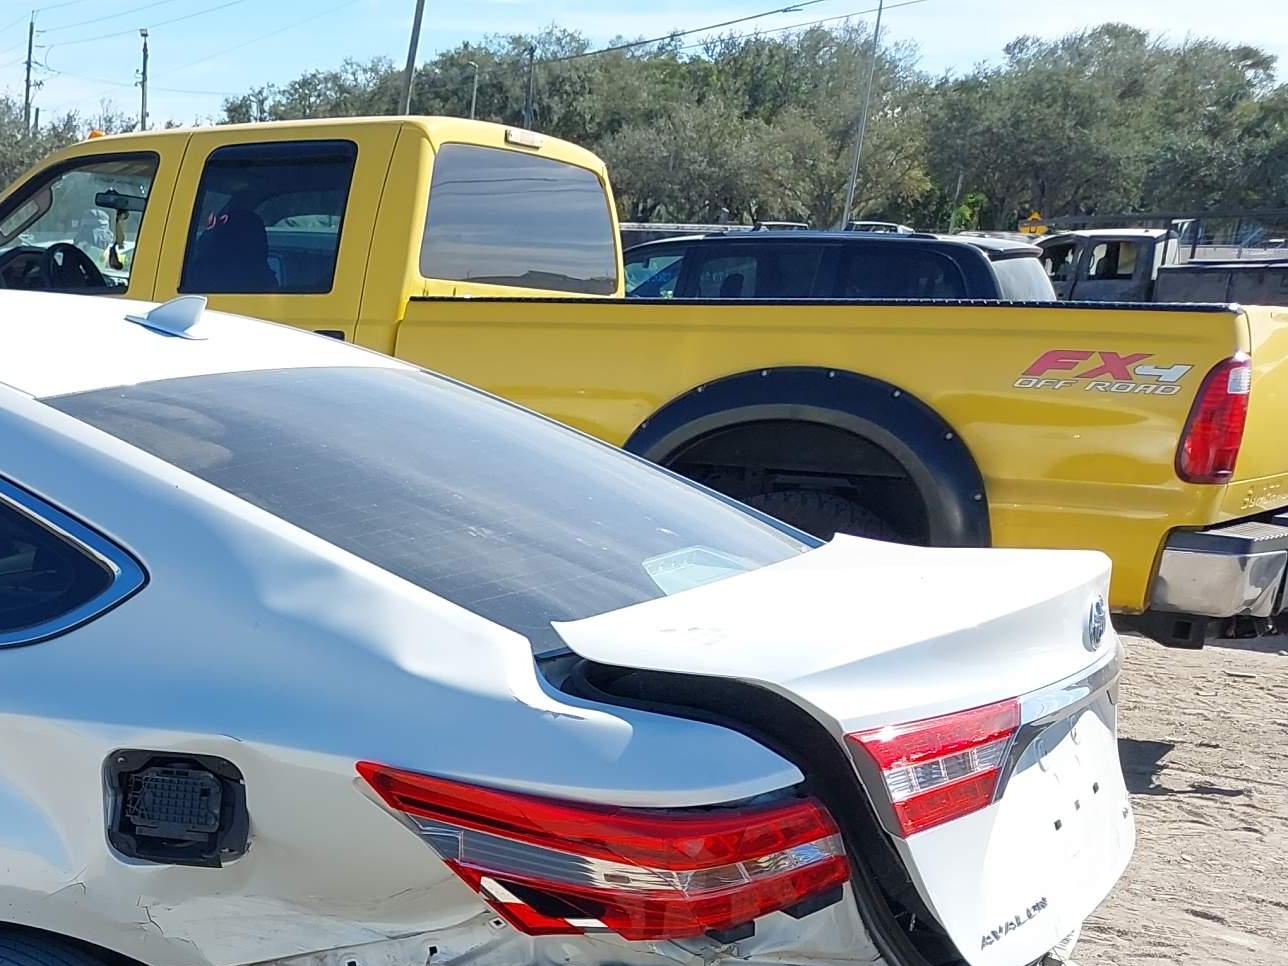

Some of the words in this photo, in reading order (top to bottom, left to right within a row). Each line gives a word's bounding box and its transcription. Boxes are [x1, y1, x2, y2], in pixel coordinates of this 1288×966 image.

[1021, 350, 1194, 382] FX4
[1013, 378, 1078, 390] OFF
[1084, 381, 1182, 395] ROAD
